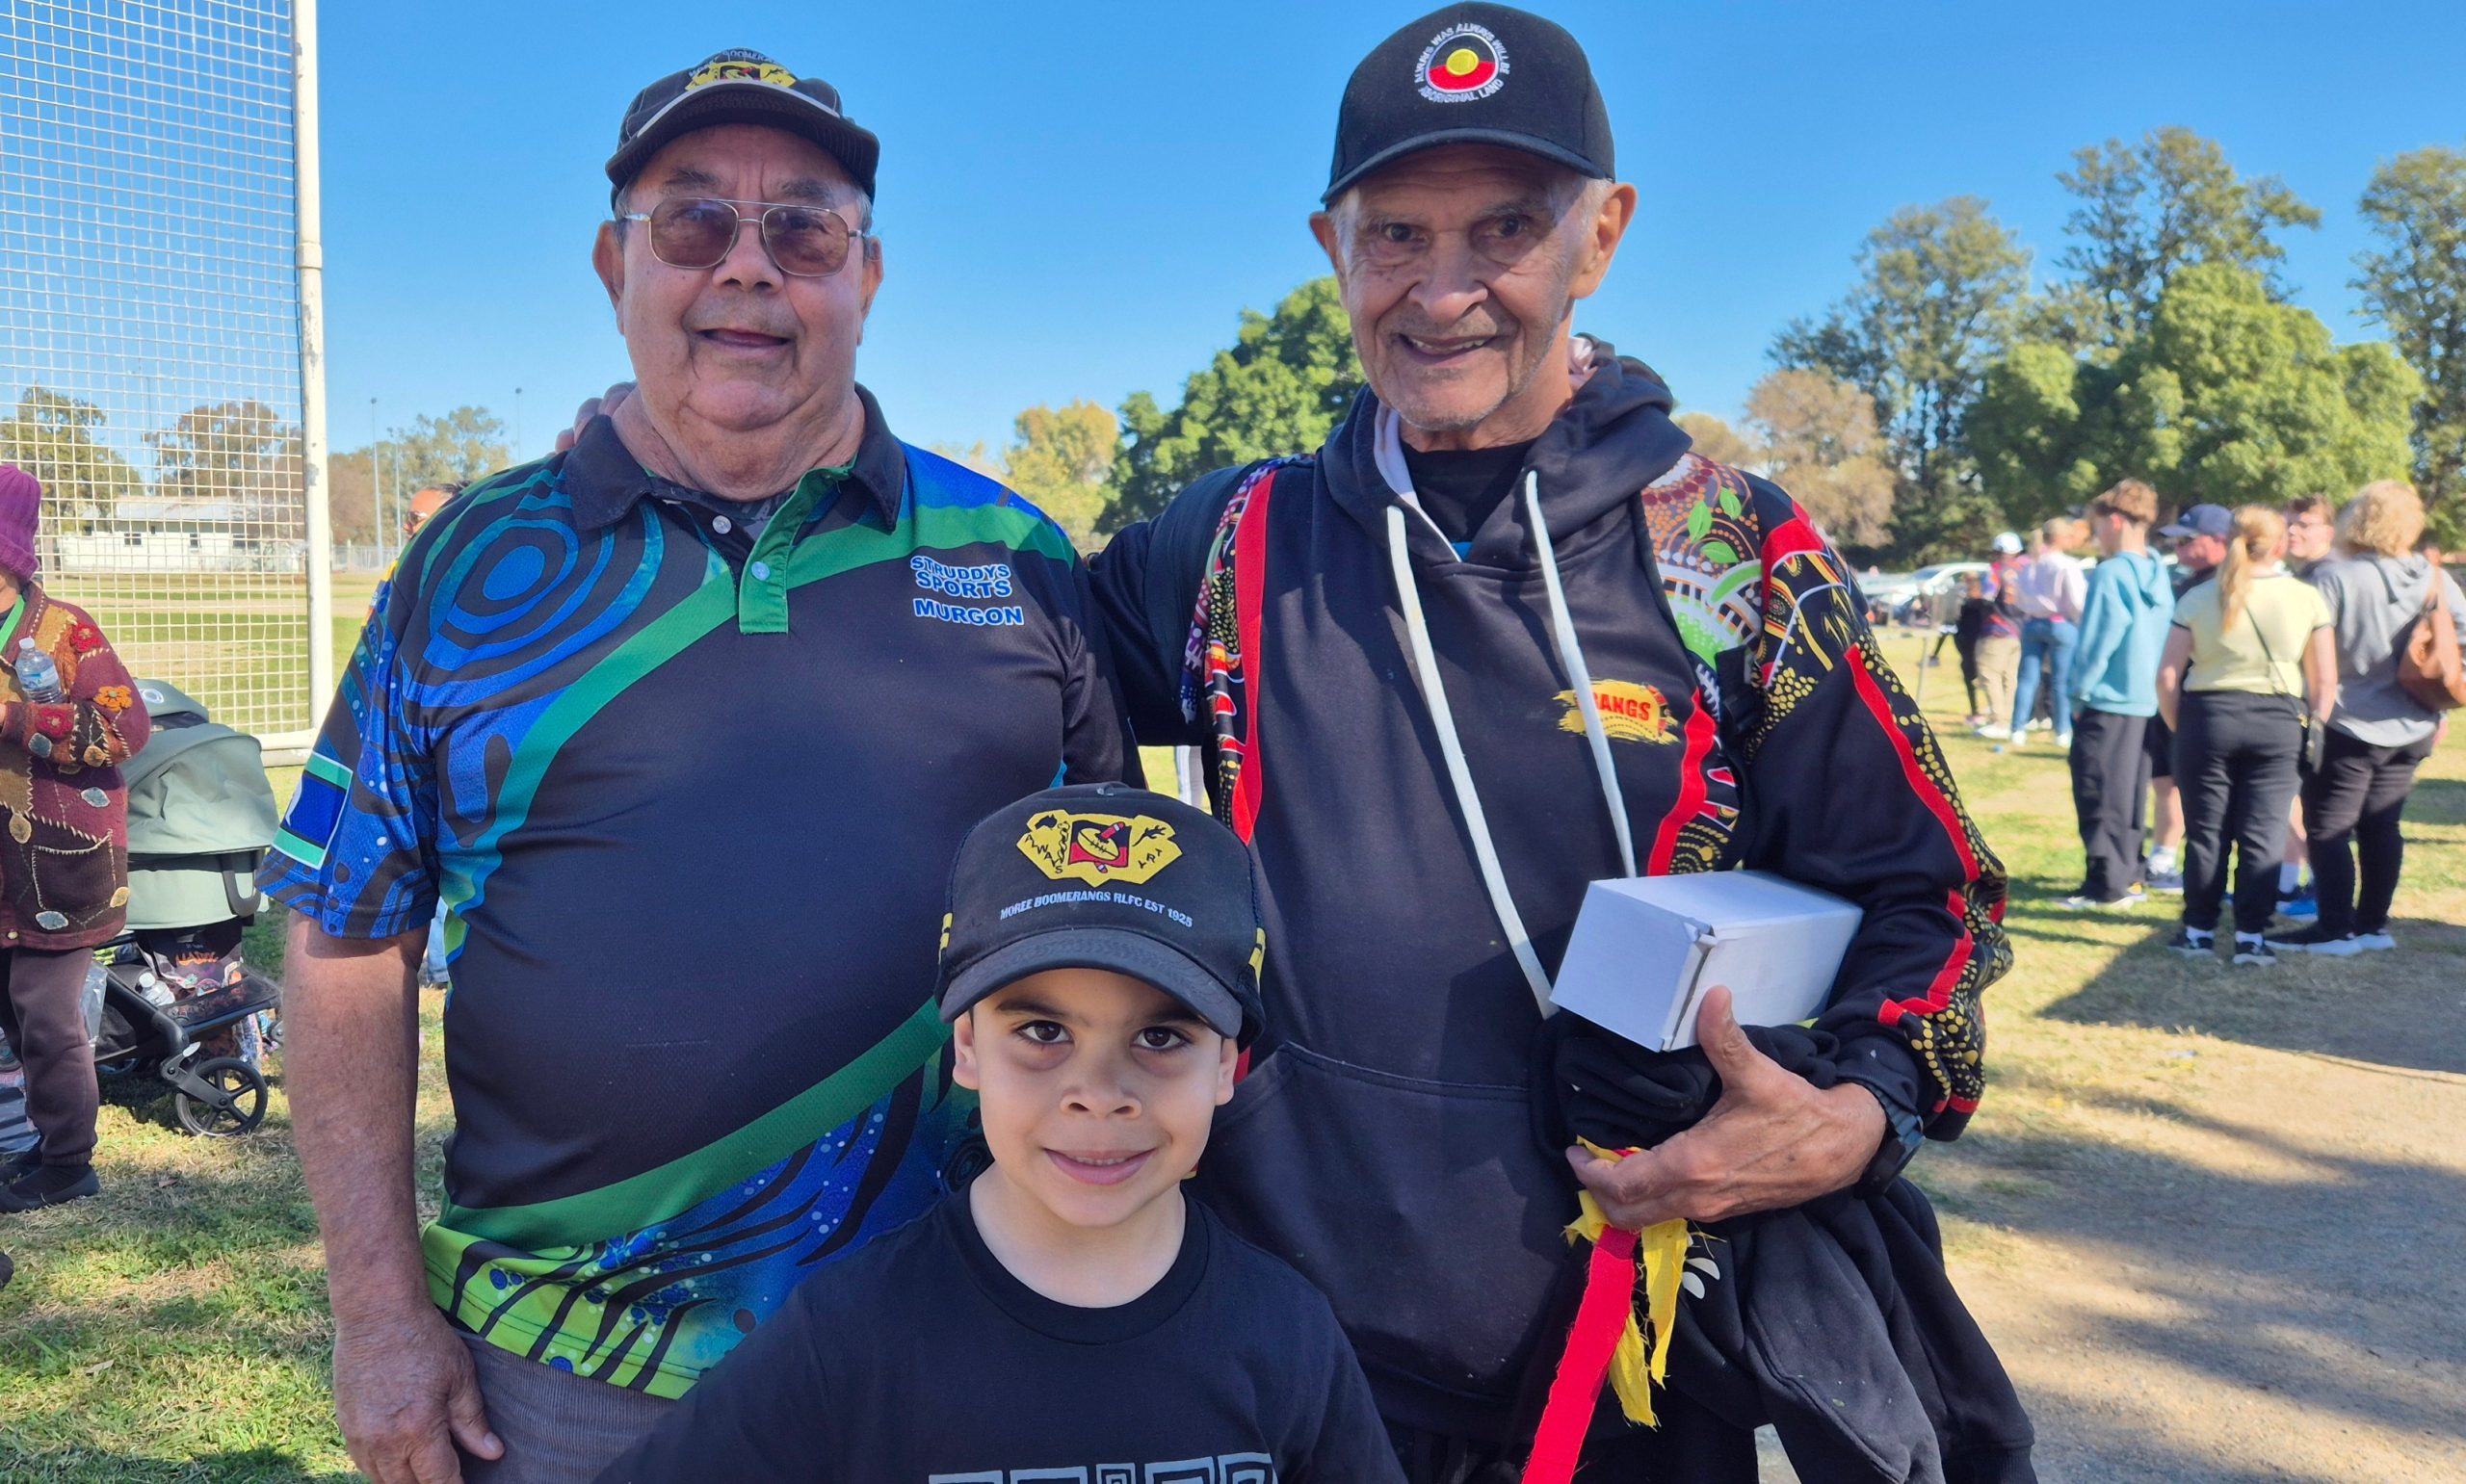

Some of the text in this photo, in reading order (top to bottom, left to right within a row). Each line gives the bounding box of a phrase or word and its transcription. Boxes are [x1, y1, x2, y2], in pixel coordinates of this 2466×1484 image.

[1430, 27, 1455, 46] WAS
[1456, 23, 1495, 41] ALWAYS
[1491, 39, 1509, 61] WILL
[1478, 78, 1505, 98] LAND
[910, 556, 1011, 582] STRUDDYS
[915, 570, 1012, 598] SPORTS
[913, 598, 1024, 626] MURGON
[1024, 834, 1063, 874] ALWAYS
[1000, 890, 1194, 928] MOREE BOOMERANGS RLFC EST 1925
